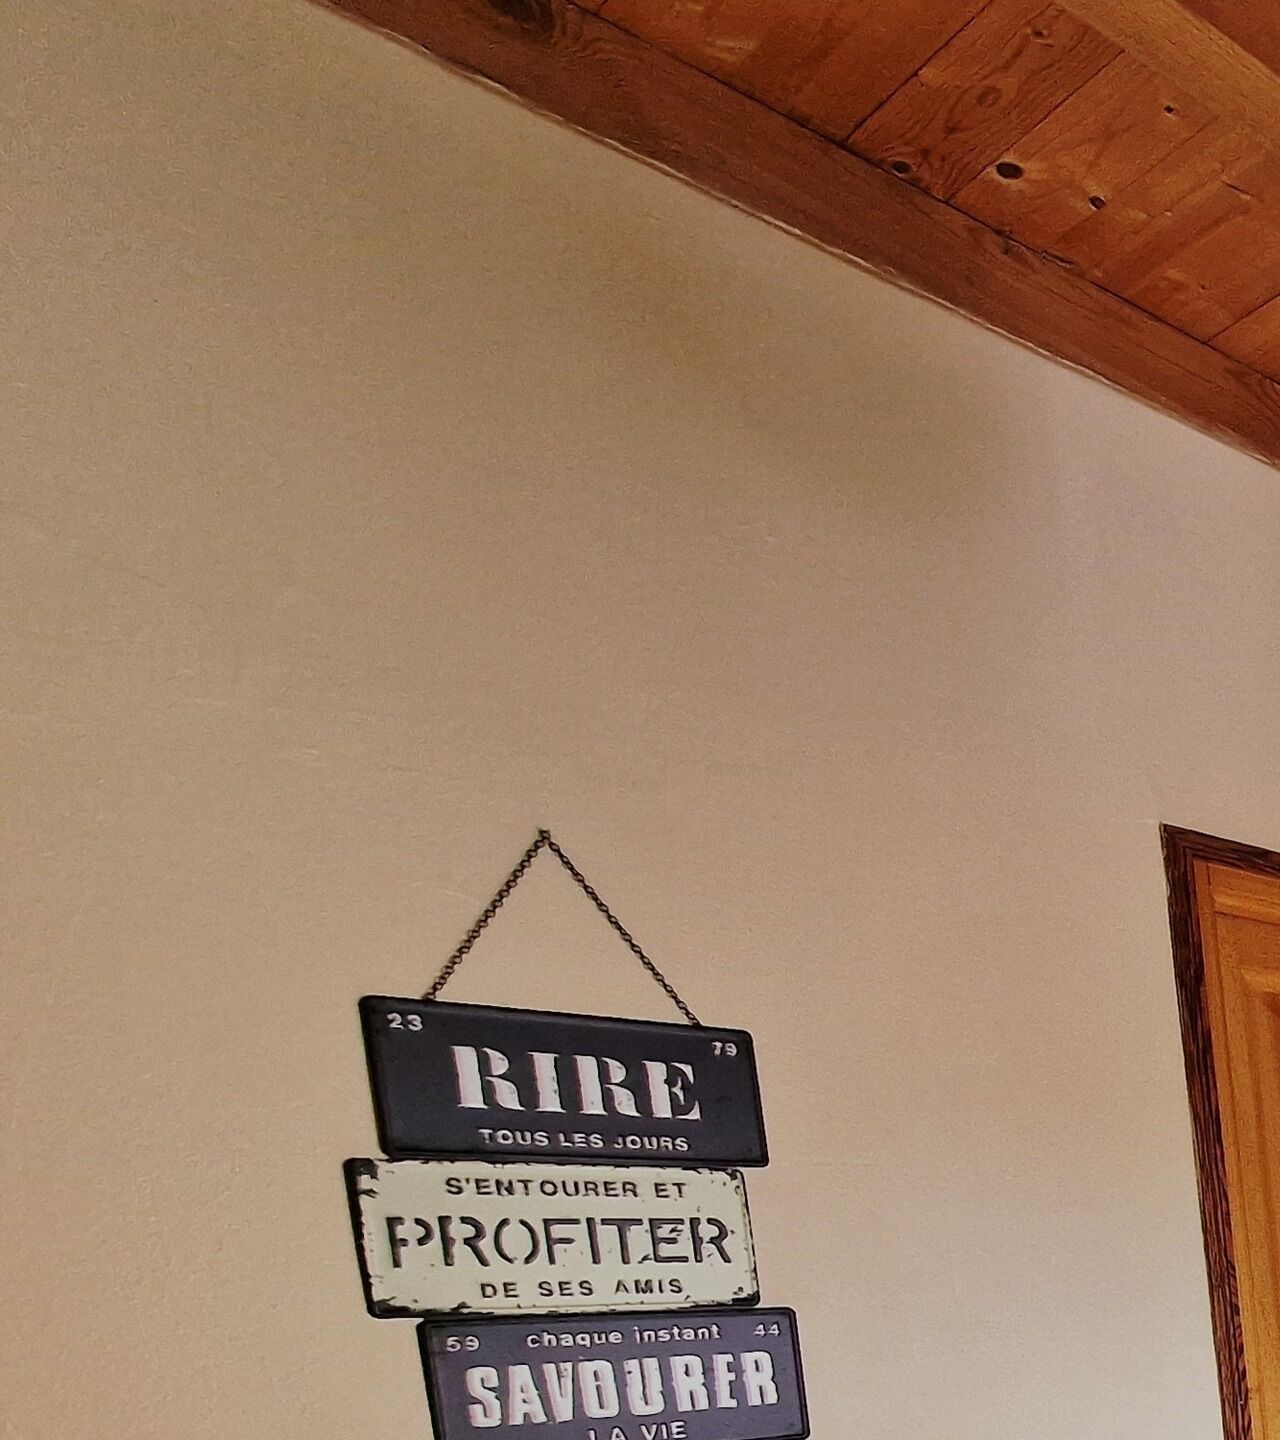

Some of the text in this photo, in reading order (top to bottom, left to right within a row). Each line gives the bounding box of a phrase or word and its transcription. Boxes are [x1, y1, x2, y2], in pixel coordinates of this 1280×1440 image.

[387, 1013, 423, 1031] 23
[450, 1044, 701, 1120] RIRE
[479, 1128, 689, 1152] TOUS LES JOURS
[446, 1177, 687, 1199] S'ENTOURER ET
[386, 1215, 736, 1268] PROFITER
[481, 1279, 684, 1299] DE SES AMIS
[526, 1323, 721, 1349] chaque instant
[753, 1322, 781, 1337] 44
[446, 1336, 481, 1353] 59
[465, 1350, 780, 1428] SAVOURER
[640, 1421, 688, 1440] VIE
